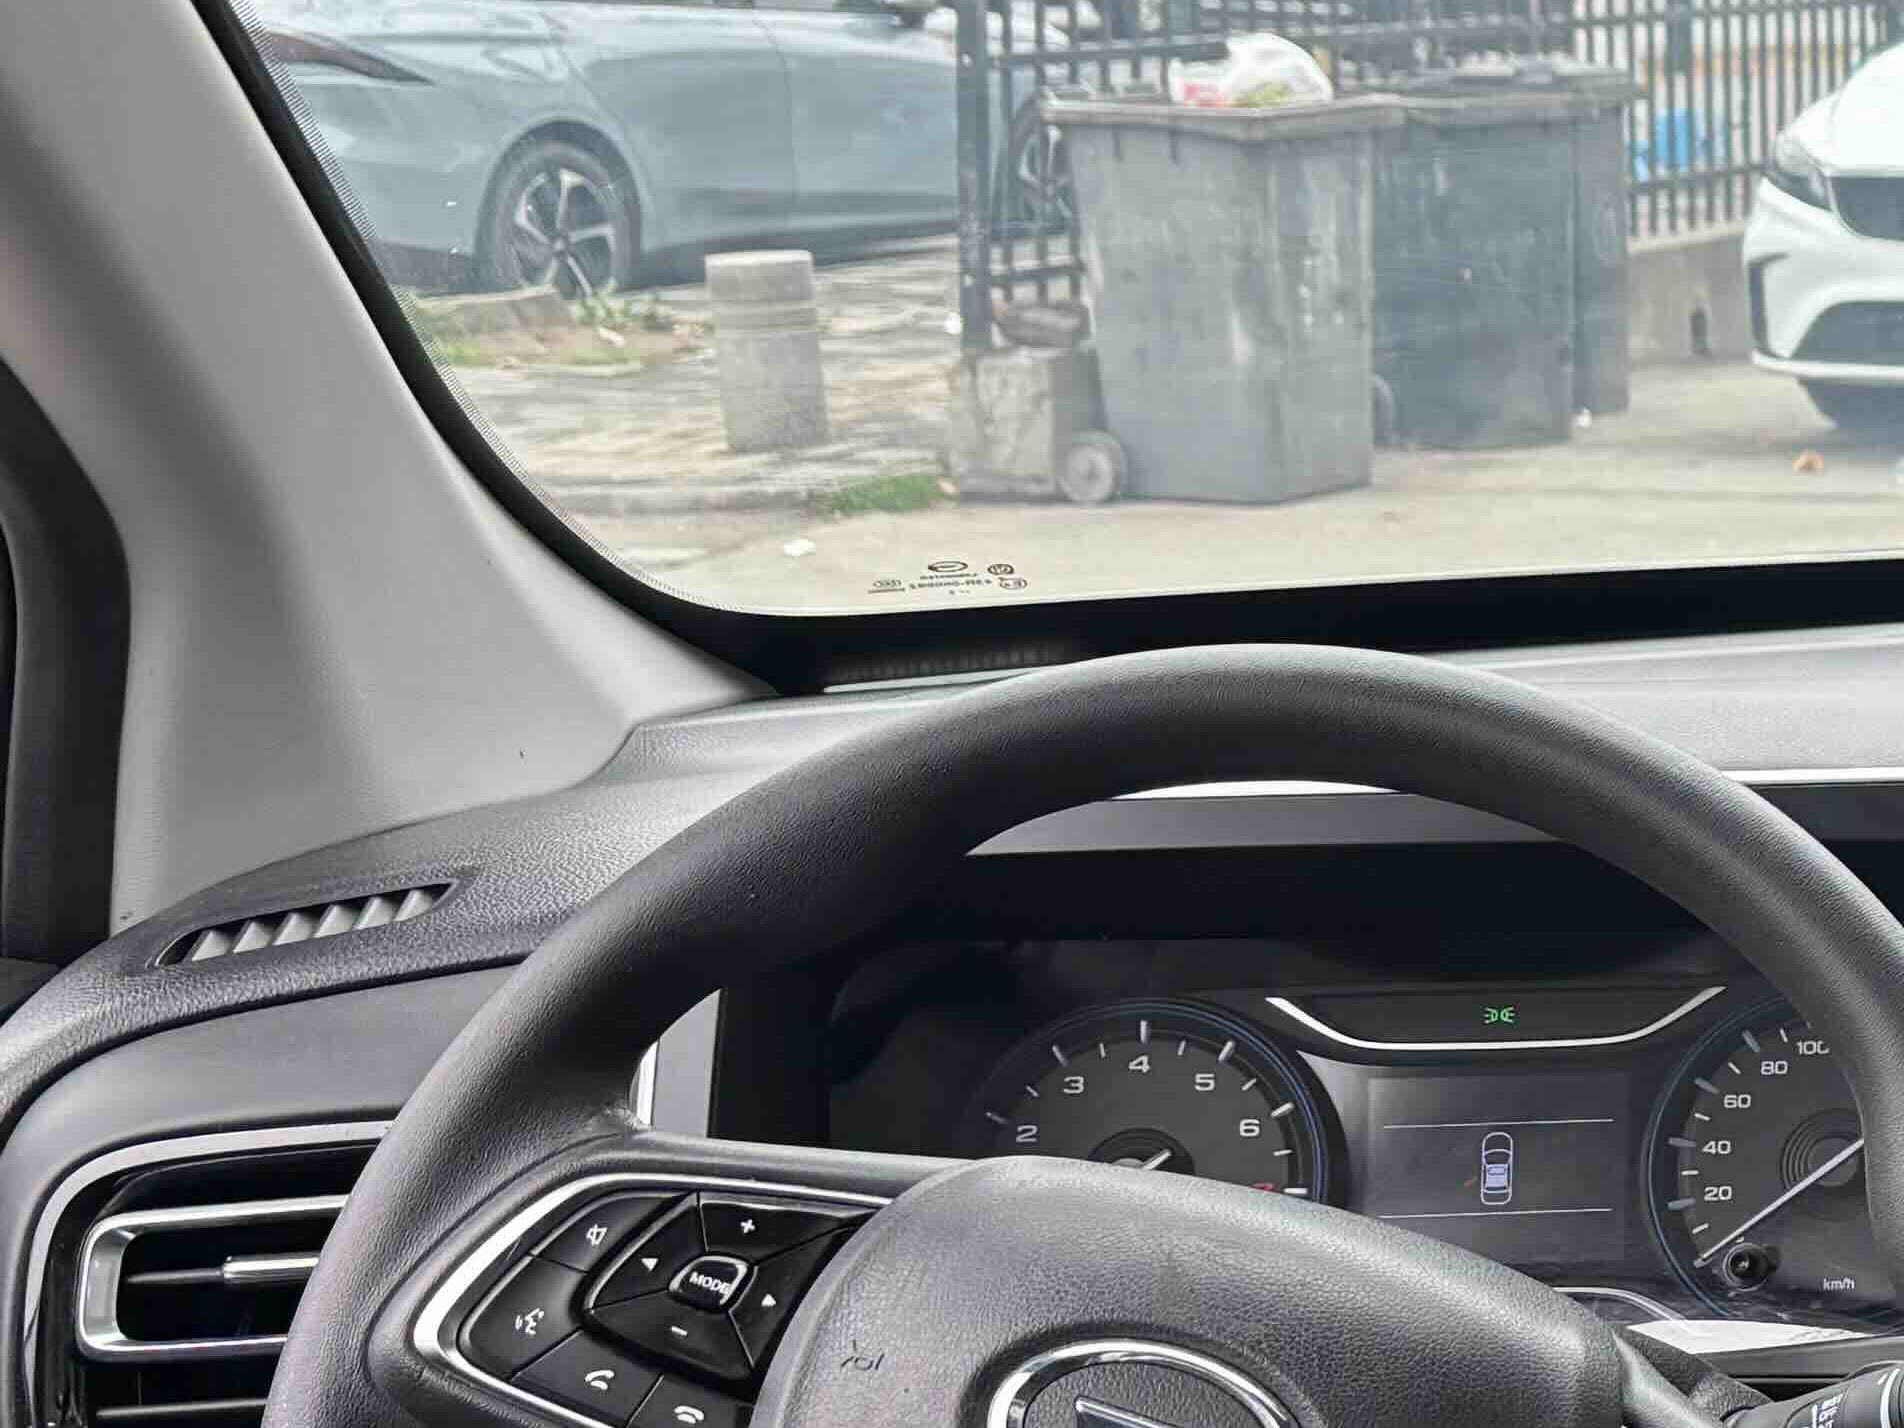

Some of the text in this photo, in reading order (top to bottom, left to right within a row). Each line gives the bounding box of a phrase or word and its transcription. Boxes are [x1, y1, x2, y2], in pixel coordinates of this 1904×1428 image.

[1128, 1055, 1150, 1073] 4
[1760, 1060, 1788, 1075] 80
[1063, 1076, 1085, 1094] 3
[1194, 1073, 1216, 1091] 5
[1724, 1093, 1751, 1109] 60
[1015, 1124, 1039, 1143] 2
[1239, 1118, 1261, 1137] 6
[1702, 1139, 1732, 1156] 40
[1703, 1185, 1733, 1201] 20
[688, 1270, 733, 1295] MODE
[1822, 1276, 1856, 1291] km/h
